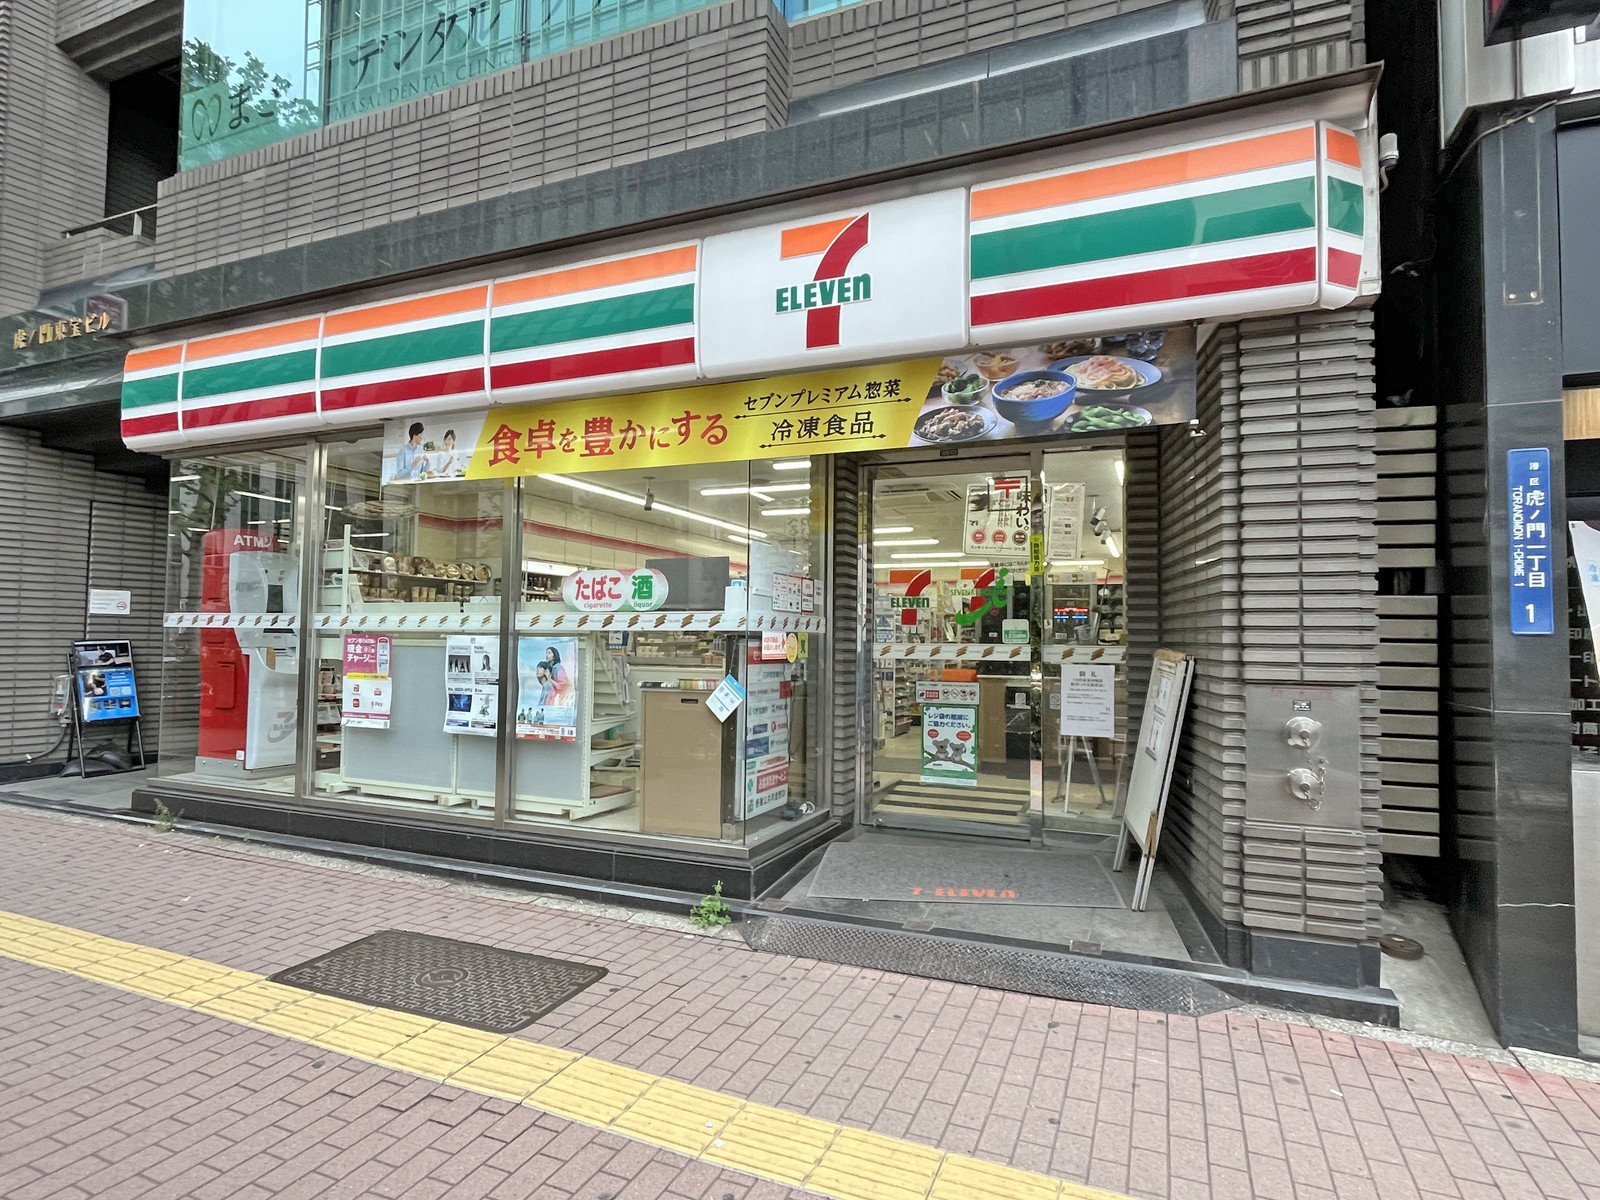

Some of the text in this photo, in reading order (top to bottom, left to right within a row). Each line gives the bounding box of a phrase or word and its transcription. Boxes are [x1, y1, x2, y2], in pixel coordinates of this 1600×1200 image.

[389, 73, 448, 103] DENTAL
[456, 50, 514, 80] CLINIC
[743, 379, 902, 411] セブンプレミアム惣菜
[487, 410, 729, 468] 食卓を豊かにする
[771, 411, 875, 441] 冷凍食品
[1512, 485, 1524, 541] TORANOMON
[234, 534, 264, 548] ATM
[1525, 490, 1547, 588] 虎ノ門一丁目
[1514, 544, 1525, 577] 1-CHOME
[575, 575, 654, 601] たばこ 酒
[583, 601, 613, 609] cigarette
[1525, 603, 1536, 624] 1
[347, 653, 370, 662] チャージ
